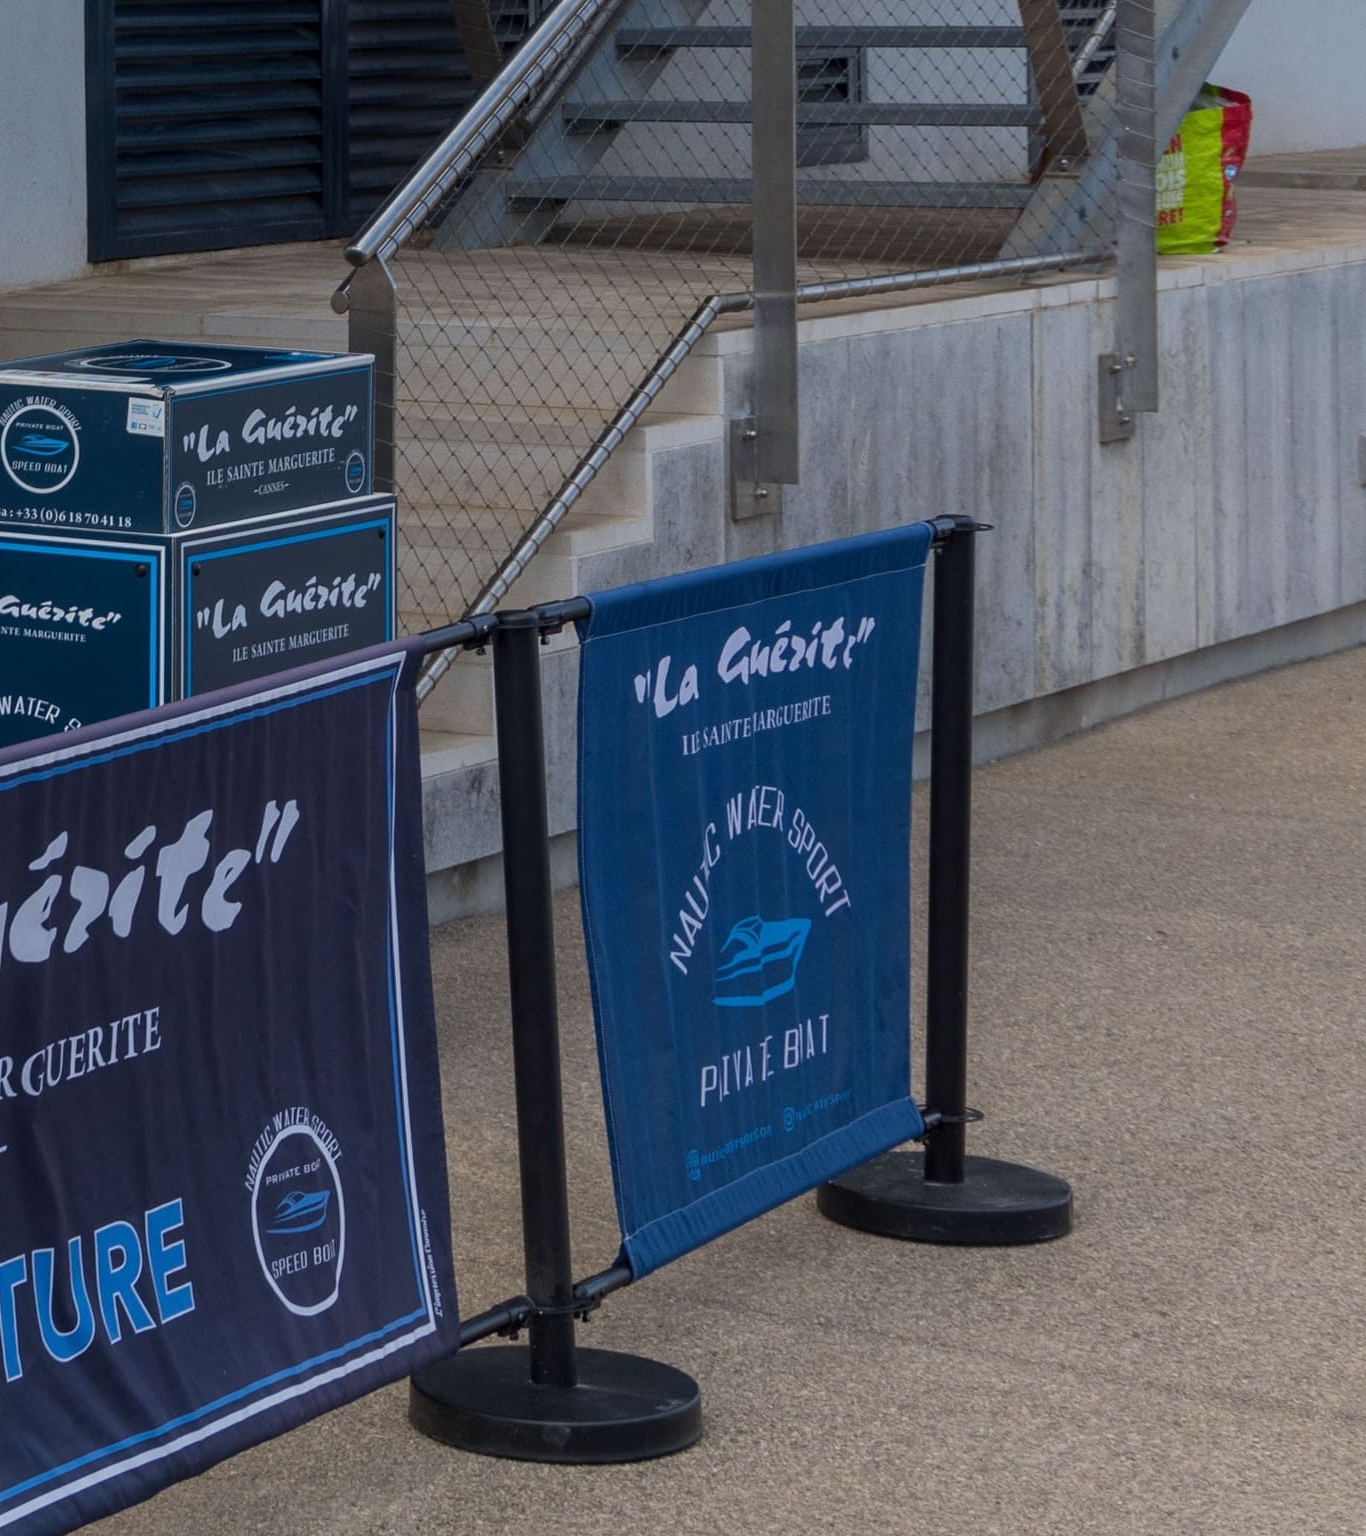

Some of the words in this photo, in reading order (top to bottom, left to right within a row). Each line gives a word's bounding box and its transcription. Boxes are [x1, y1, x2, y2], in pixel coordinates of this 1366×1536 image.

[26, 396, 57, 408] WATER
[183, 424, 230, 462] "La
[242, 404, 358, 445] Guérite"
[12, 461, 41, 472] SPEED
[44, 463, 68, 474] BOAT
[207, 469, 224, 486] ILE
[227, 461, 264, 482] SAINTE
[268, 447, 335, 474] MARGUERITE
[196, 598, 248, 639] "La
[259, 572, 381, 618] Guérite"
[23, 628, 86, 643] MARGUERITE
[232, 646, 248, 663] ILE
[251, 638, 286, 659] SAINTE
[288, 623, 349, 650] MARGUERITE
[726, 785, 784, 841] WAER
[788, 808, 851, 917] SPORT
[700, 1035, 775, 1107] PIVATE
[783, 1014, 829, 1069] BAT
[244, 1125, 273, 1192] NAUTIC
[272, 1107, 309, 1132] WATER
[311, 1115, 343, 1161] SPORT
[266, 1167, 301, 1186] PRIVATE
[271, 1251, 308, 1279] SPEED
